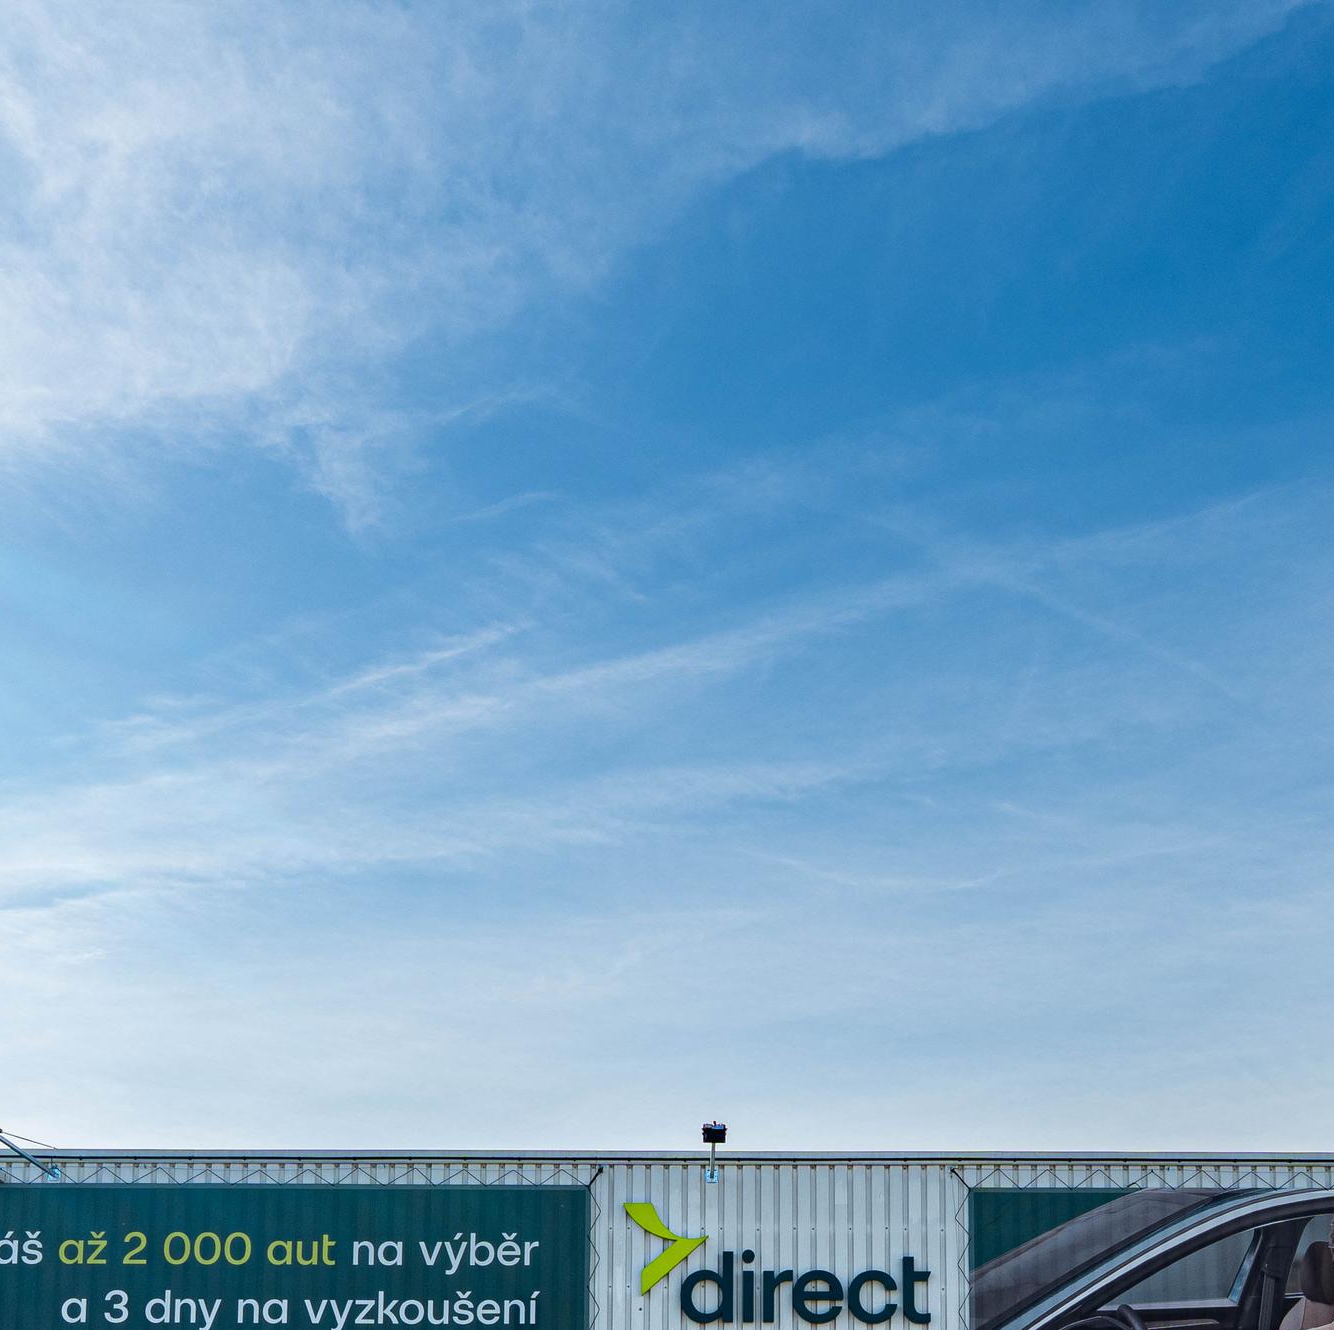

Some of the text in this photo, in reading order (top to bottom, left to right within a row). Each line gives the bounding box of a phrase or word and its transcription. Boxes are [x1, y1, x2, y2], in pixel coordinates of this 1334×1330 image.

[58, 1230, 107, 1265] až
[123, 1231, 148, 1265] 2
[163, 1231, 252, 1266] 000
[267, 1233, 337, 1266] aut
[353, 1240, 404, 1267] na
[419, 1232, 540, 1276] výběr
[60, 1297, 87, 1324] a
[103, 1289, 129, 1324] 3
[237, 1298, 289, 1325] na
[680, 1249, 932, 1325] direct
